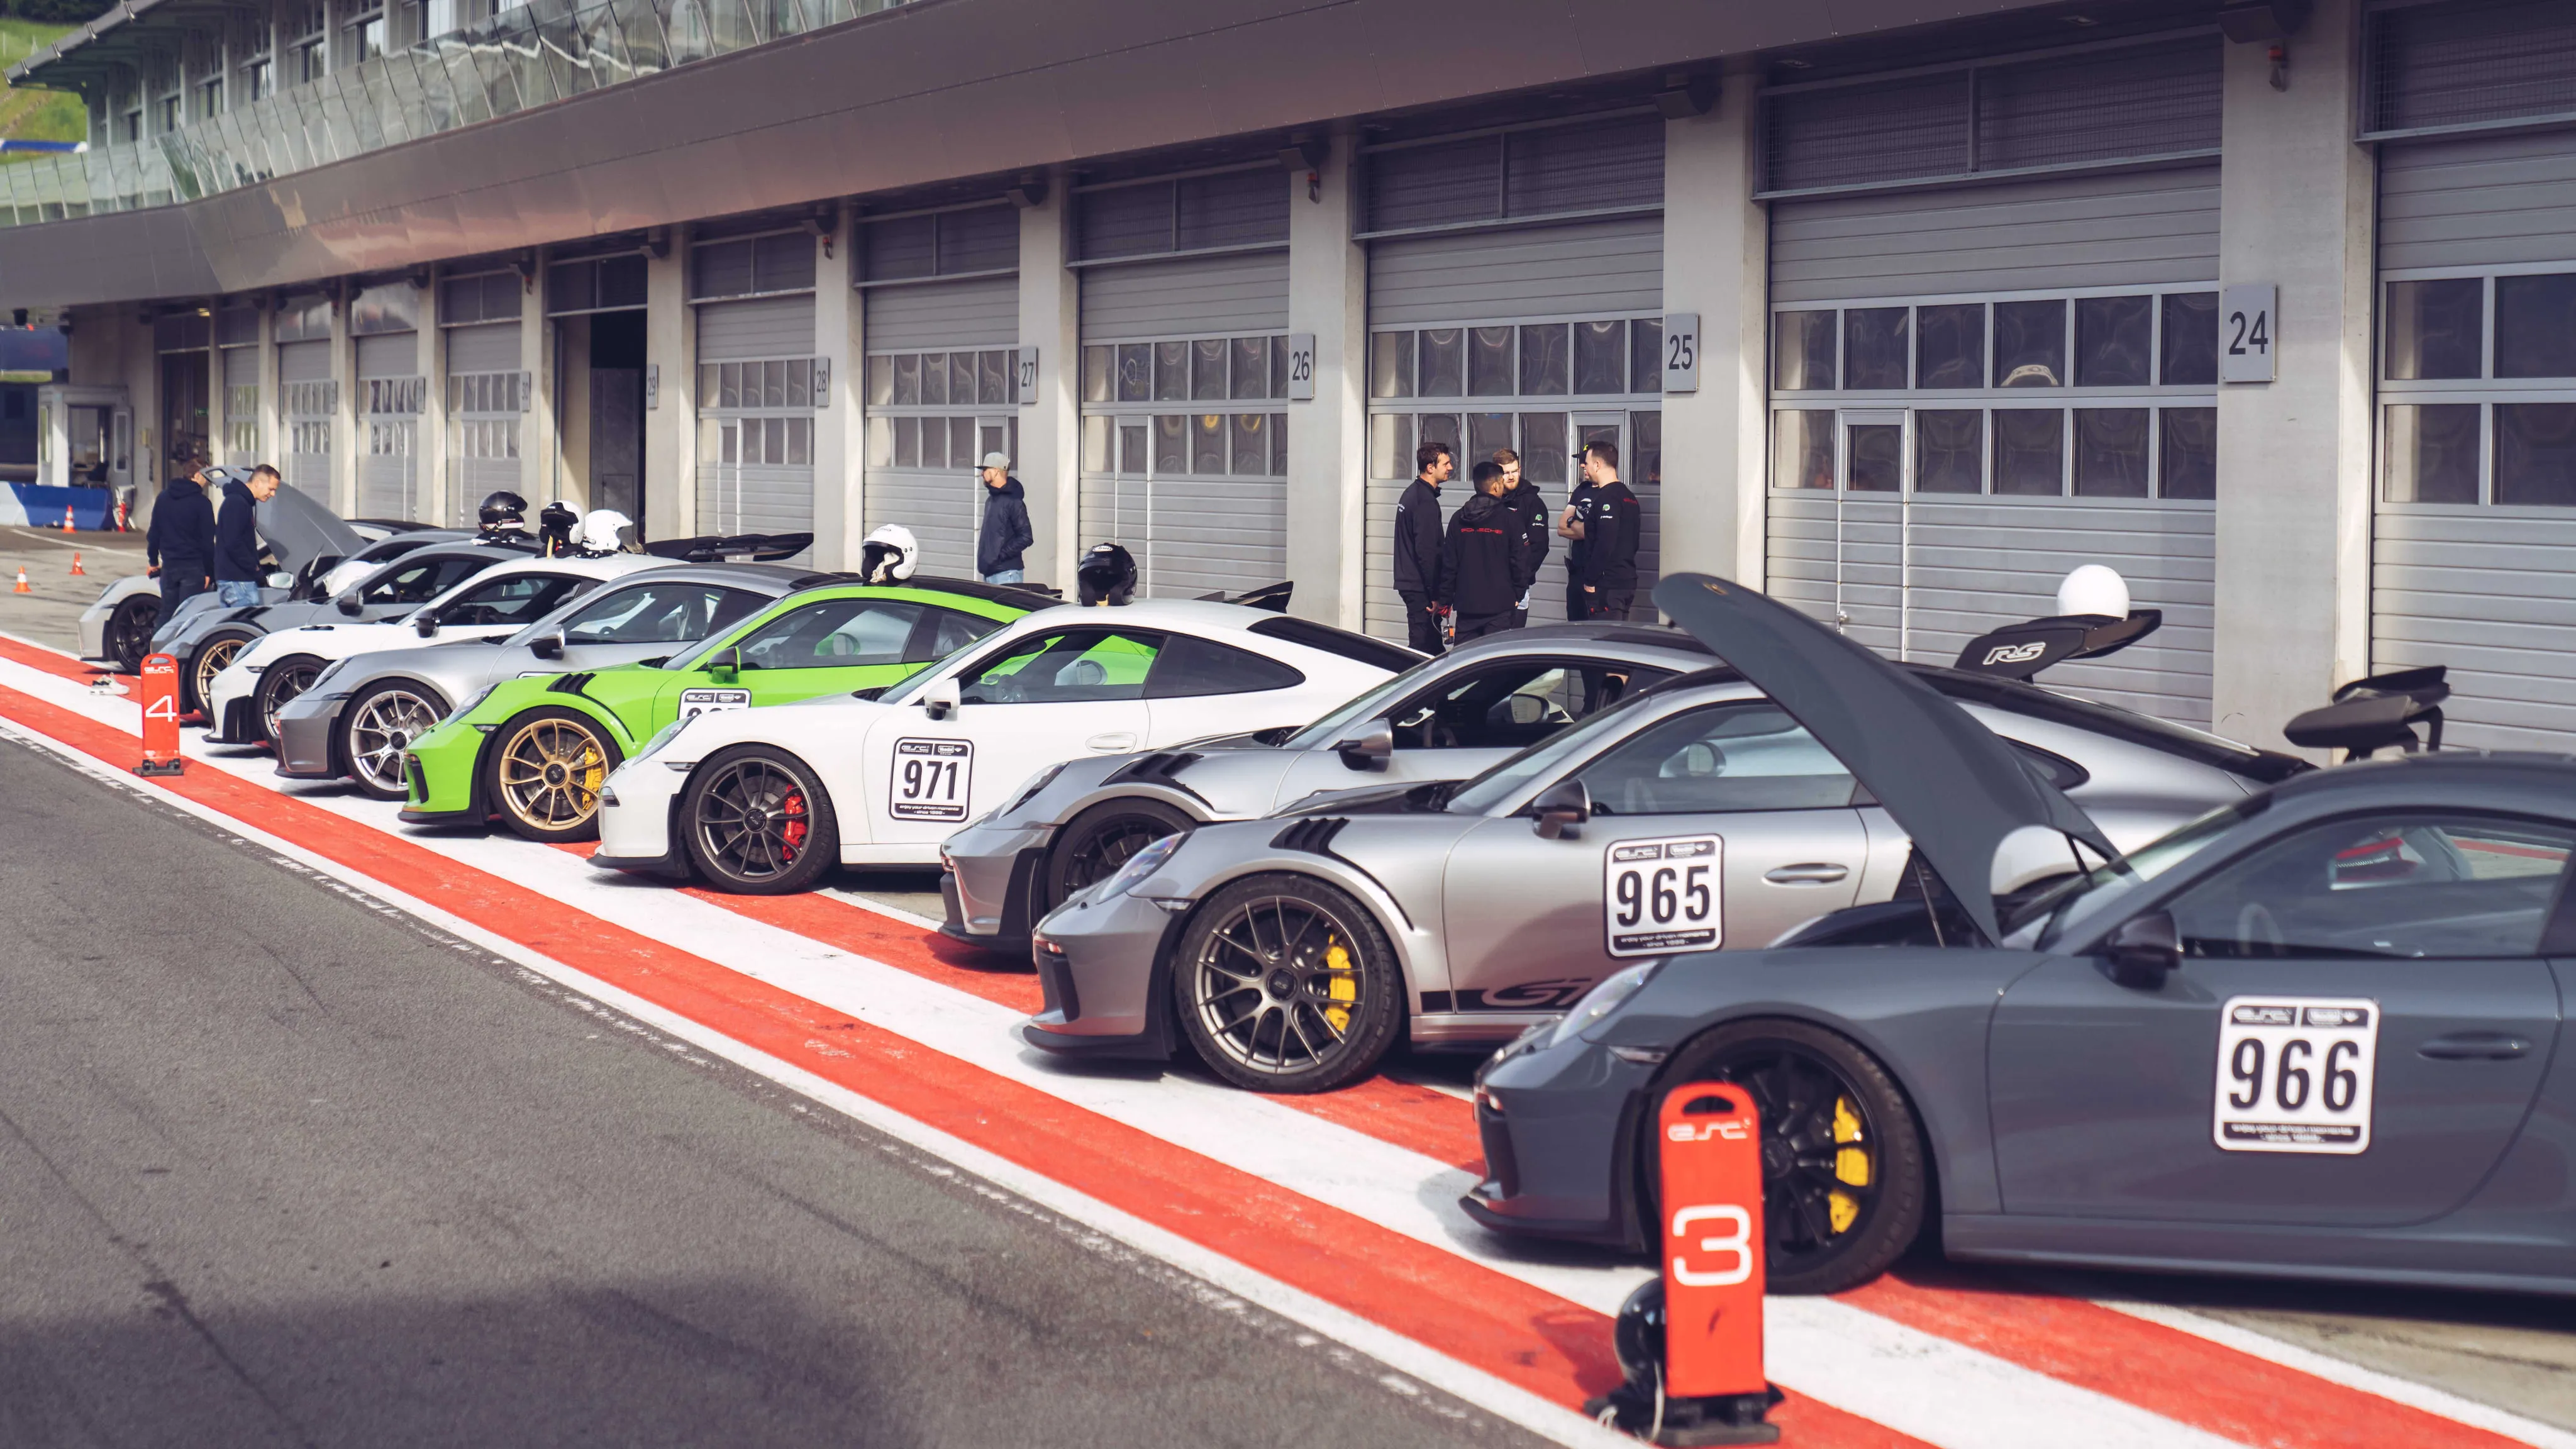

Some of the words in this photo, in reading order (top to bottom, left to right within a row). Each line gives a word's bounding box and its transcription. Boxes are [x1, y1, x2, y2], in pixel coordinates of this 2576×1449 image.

[2229, 310, 2268, 355] 24
[1292, 351, 1309, 380] 26
[1668, 334, 1692, 370] 25
[648, 376, 656, 396] 29
[816, 370, 826, 392] 28
[1021, 362, 1034, 387] 27
[1982, 641, 2046, 665] RS
[145, 695, 177, 723] 4
[903, 760, 957, 800] 971
[1617, 865, 1710, 927] 965
[2229, 1038, 2358, 1112] 966
[1672, 1204, 1753, 1286] 3
